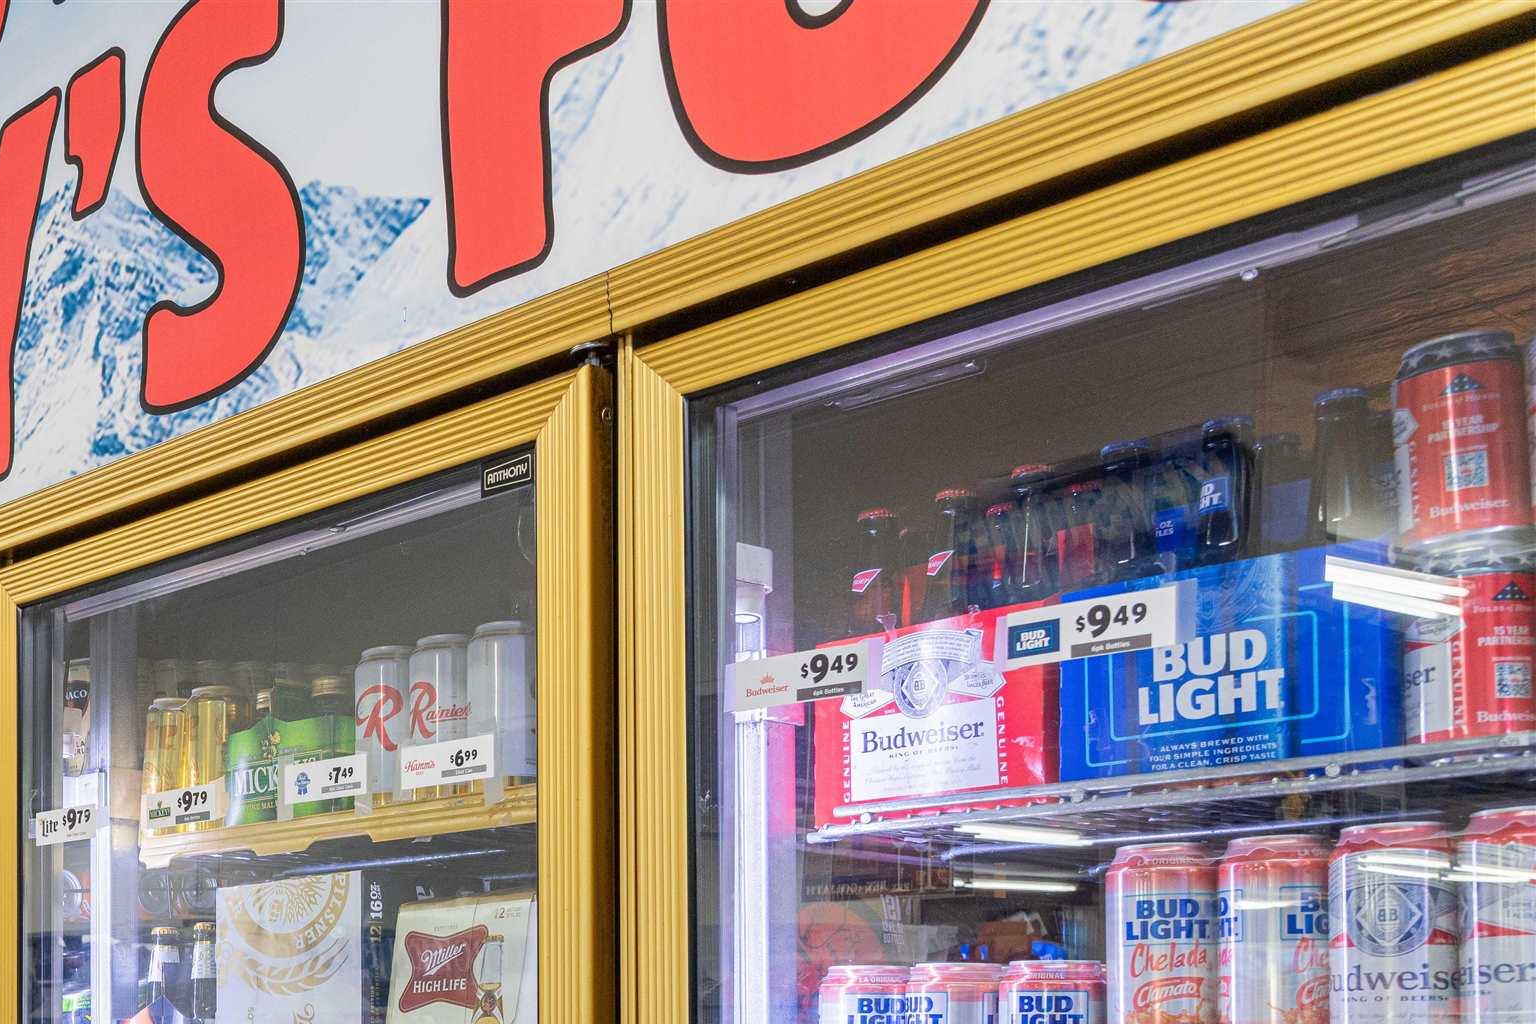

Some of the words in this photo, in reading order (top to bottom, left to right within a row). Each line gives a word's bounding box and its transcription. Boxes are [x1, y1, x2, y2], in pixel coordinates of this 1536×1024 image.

[487, 462, 528, 485] ANTHONY
[1429, 498, 1511, 520] Budweiser
[1075, 602, 1147, 638] $949
[1016, 637, 1049, 651] LIGHT
[1020, 630, 1046, 642] BUD
[1153, 629, 1267, 682] BUD
[800, 653, 858, 683] $949
[745, 684, 790, 697] Budweiser
[1138, 668, 1285, 725] LIGHT
[409, 681, 472, 739] Rainier
[861, 720, 984, 754] Budweiser
[996, 696, 1008, 784] GENUINE
[1160, 741, 1197, 753] ALWAYS
[1200, 735, 1243, 748] BREWED
[1247, 733, 1269, 743] WITH
[450, 749, 477, 767] $699
[1174, 749, 1209, 760] SIMPLE
[1213, 742, 1277, 756] INGREDIENTS
[1217, 755, 1247, 765] CRISP
[329, 767, 353, 783] $749
[177, 791, 207, 812] $979
[39, 819, 58, 837] Lite
[62, 808, 92, 831] $979
[1135, 898, 1200, 919] BUD
[1125, 919, 1212, 942] LIGHT
[421, 941, 466, 977] Miller
[1129, 943, 1208, 978] Chelada
[413, 978, 440, 994] HIGH
[440, 977, 467, 992] LIFE
[1134, 978, 1203, 1007] Clamato
[1018, 996, 1074, 1013] BUD
